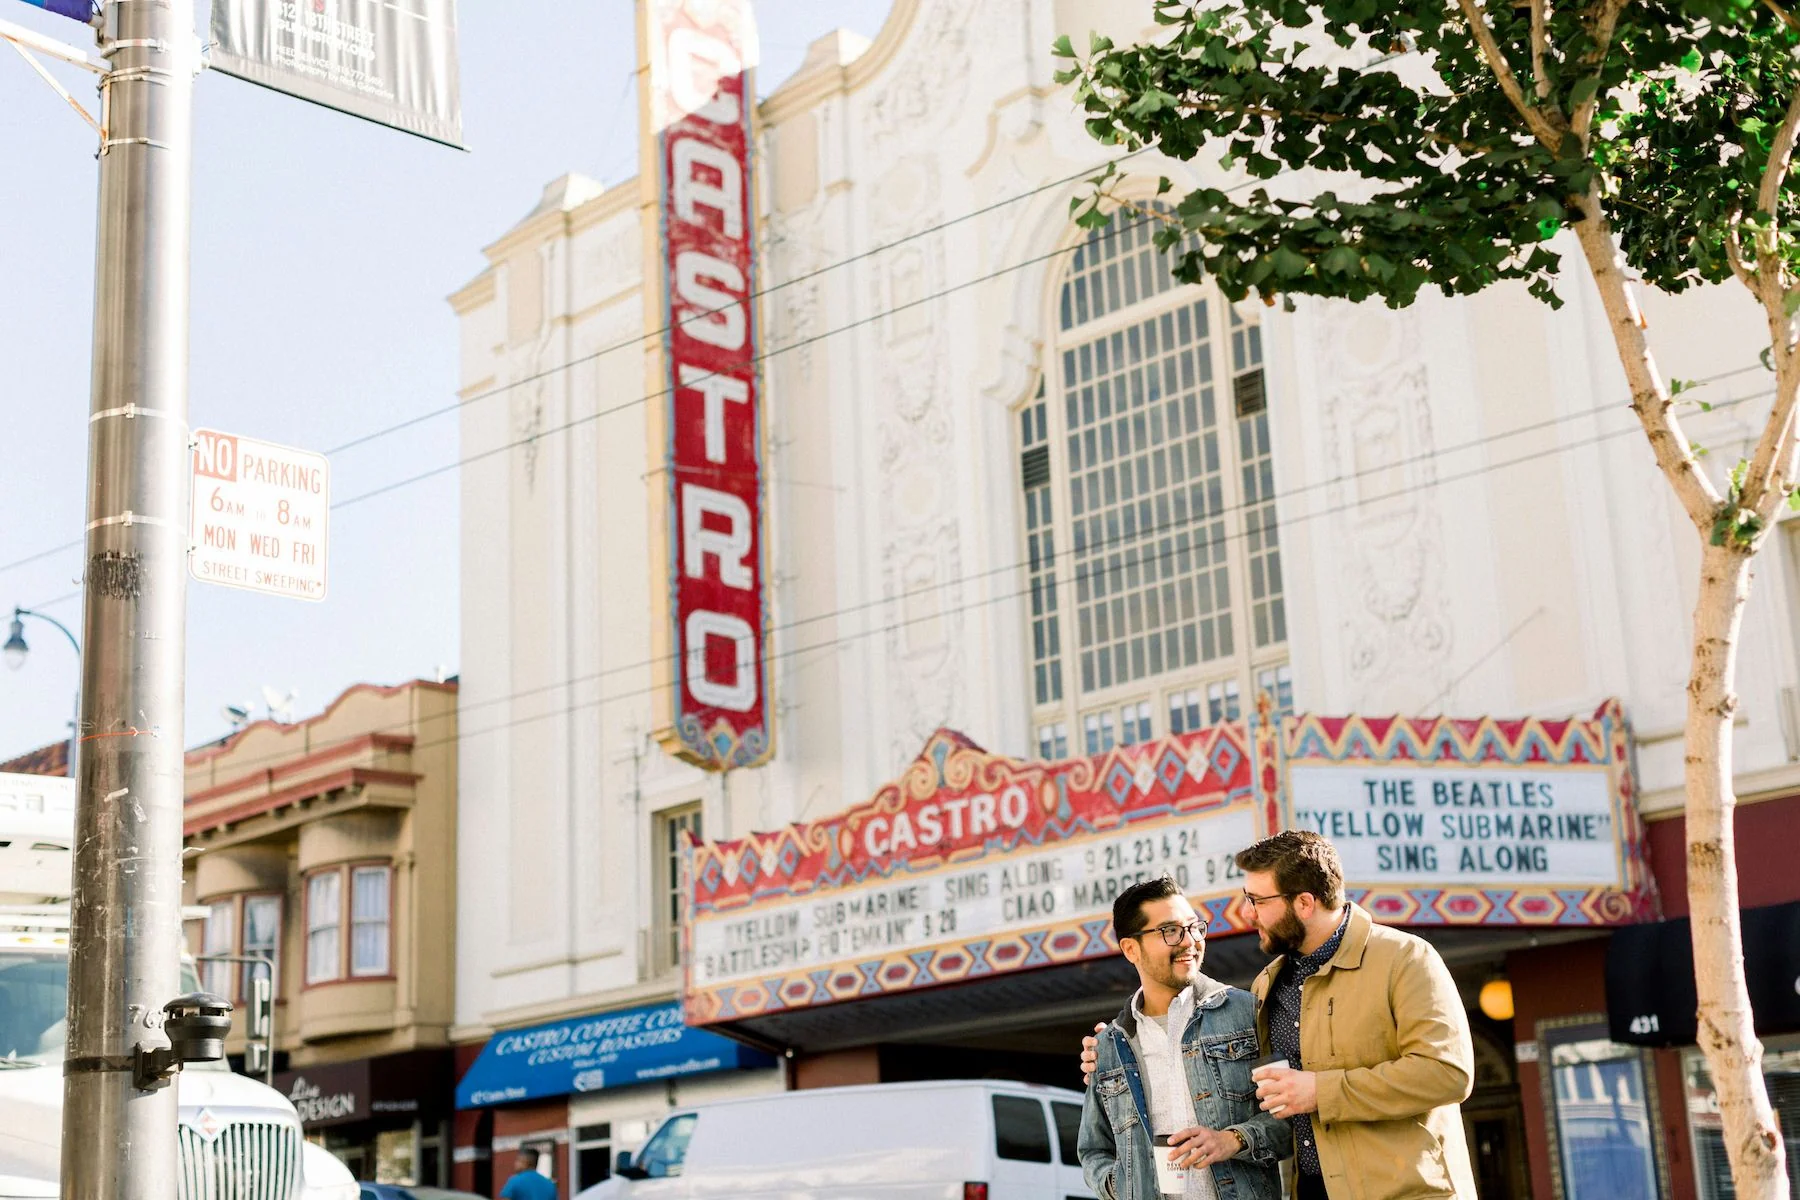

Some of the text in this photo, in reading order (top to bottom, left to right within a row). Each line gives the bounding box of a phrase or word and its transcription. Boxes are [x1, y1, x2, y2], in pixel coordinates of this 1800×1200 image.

[668, 27, 757, 713] CASTRO
[198, 434, 321, 494] NO PARKING
[204, 523, 316, 566] MON WED FRI
[202, 560, 248, 582] STREET
[1363, 779, 1555, 809] THE BEATLES
[864, 785, 1029, 857] CASTRO
[1295, 810, 1612, 841] "YELLOW SUBMARINE"
[944, 872, 989, 903] SING
[1000, 858, 1064, 893] ALONG
[1084, 850, 1095, 873] 9
[1178, 828, 1199, 856] 24
[1376, 844, 1549, 873] SING ALONG
[1002, 889, 1055, 921] CIAO
[1205, 858, 1216, 884] 9
[495, 1026, 571, 1056] CASTRO
[570, 1011, 647, 1043] COFFEE
[596, 1027, 683, 1055] ROASTERS
[1629, 1013, 1660, 1035] 431
